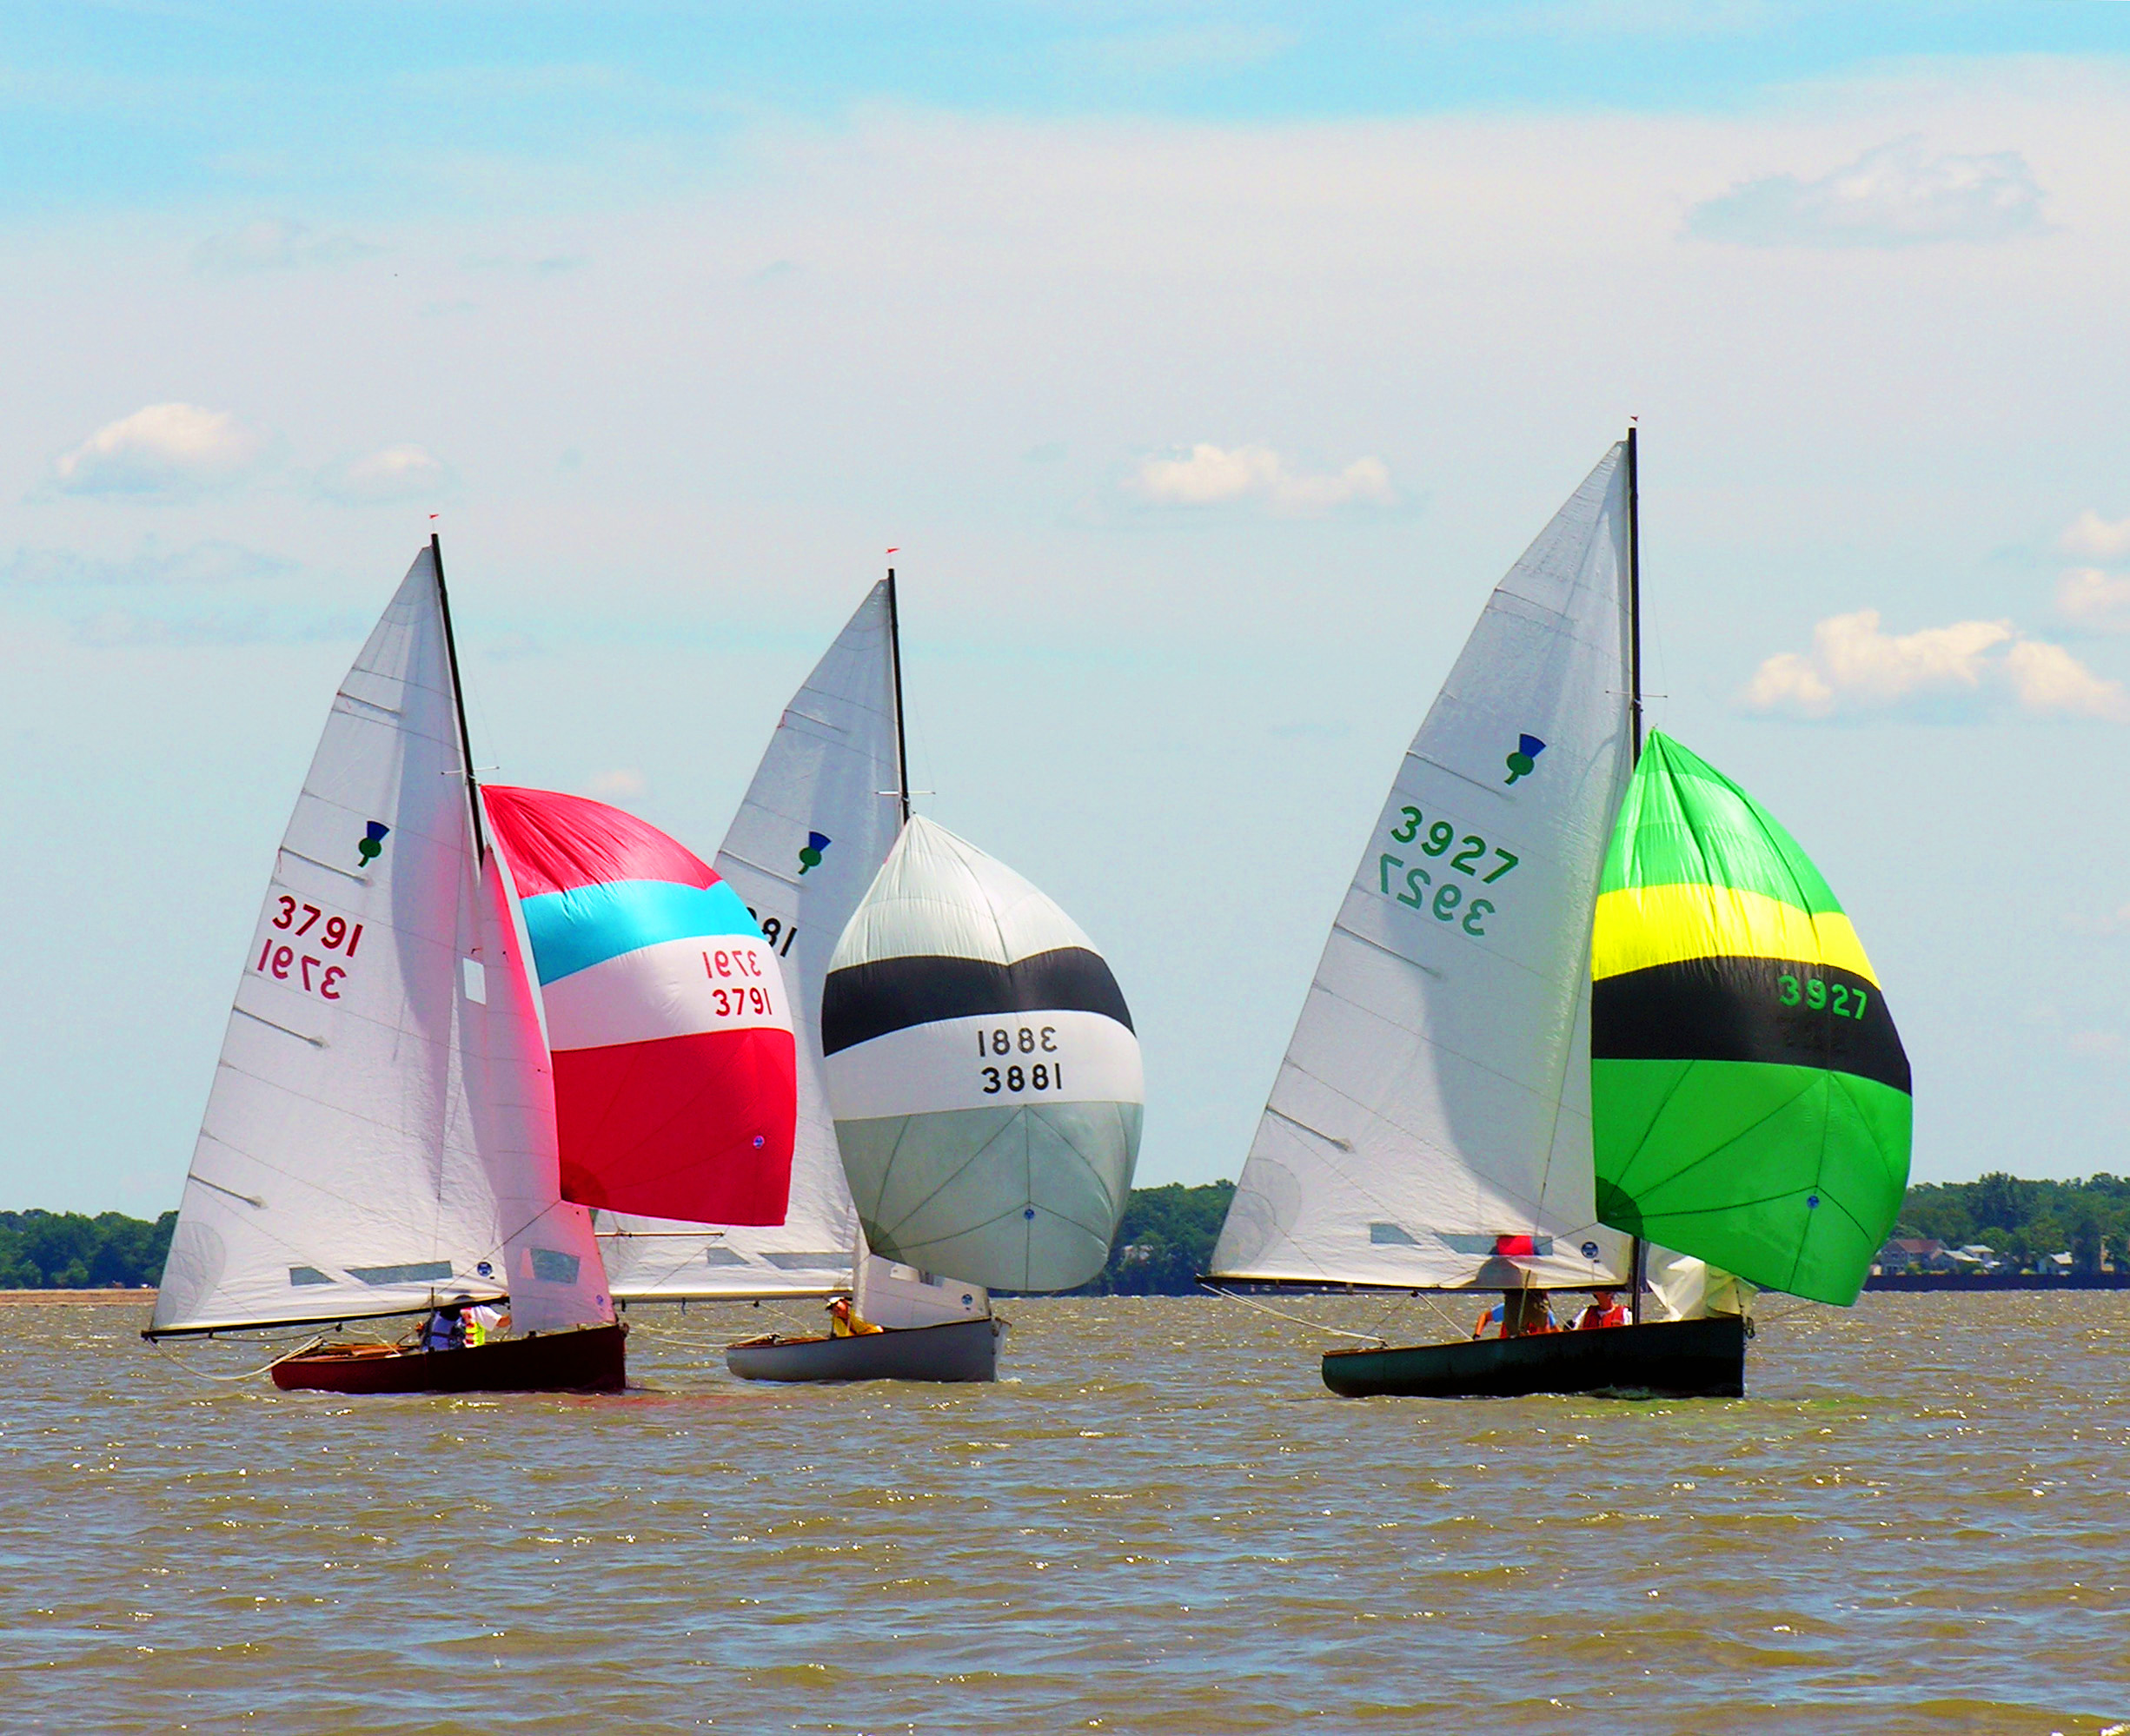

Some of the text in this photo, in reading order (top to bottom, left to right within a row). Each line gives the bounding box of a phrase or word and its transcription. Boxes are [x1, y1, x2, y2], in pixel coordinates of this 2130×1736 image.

[1390, 805, 1518, 885] 3927
[272, 896, 363, 957] 3791
[746, 906, 798, 957] 81
[713, 987, 772, 1017] 3791
[1778, 974, 1868, 1020] 3927
[981, 1063, 1062, 1094] 3881
